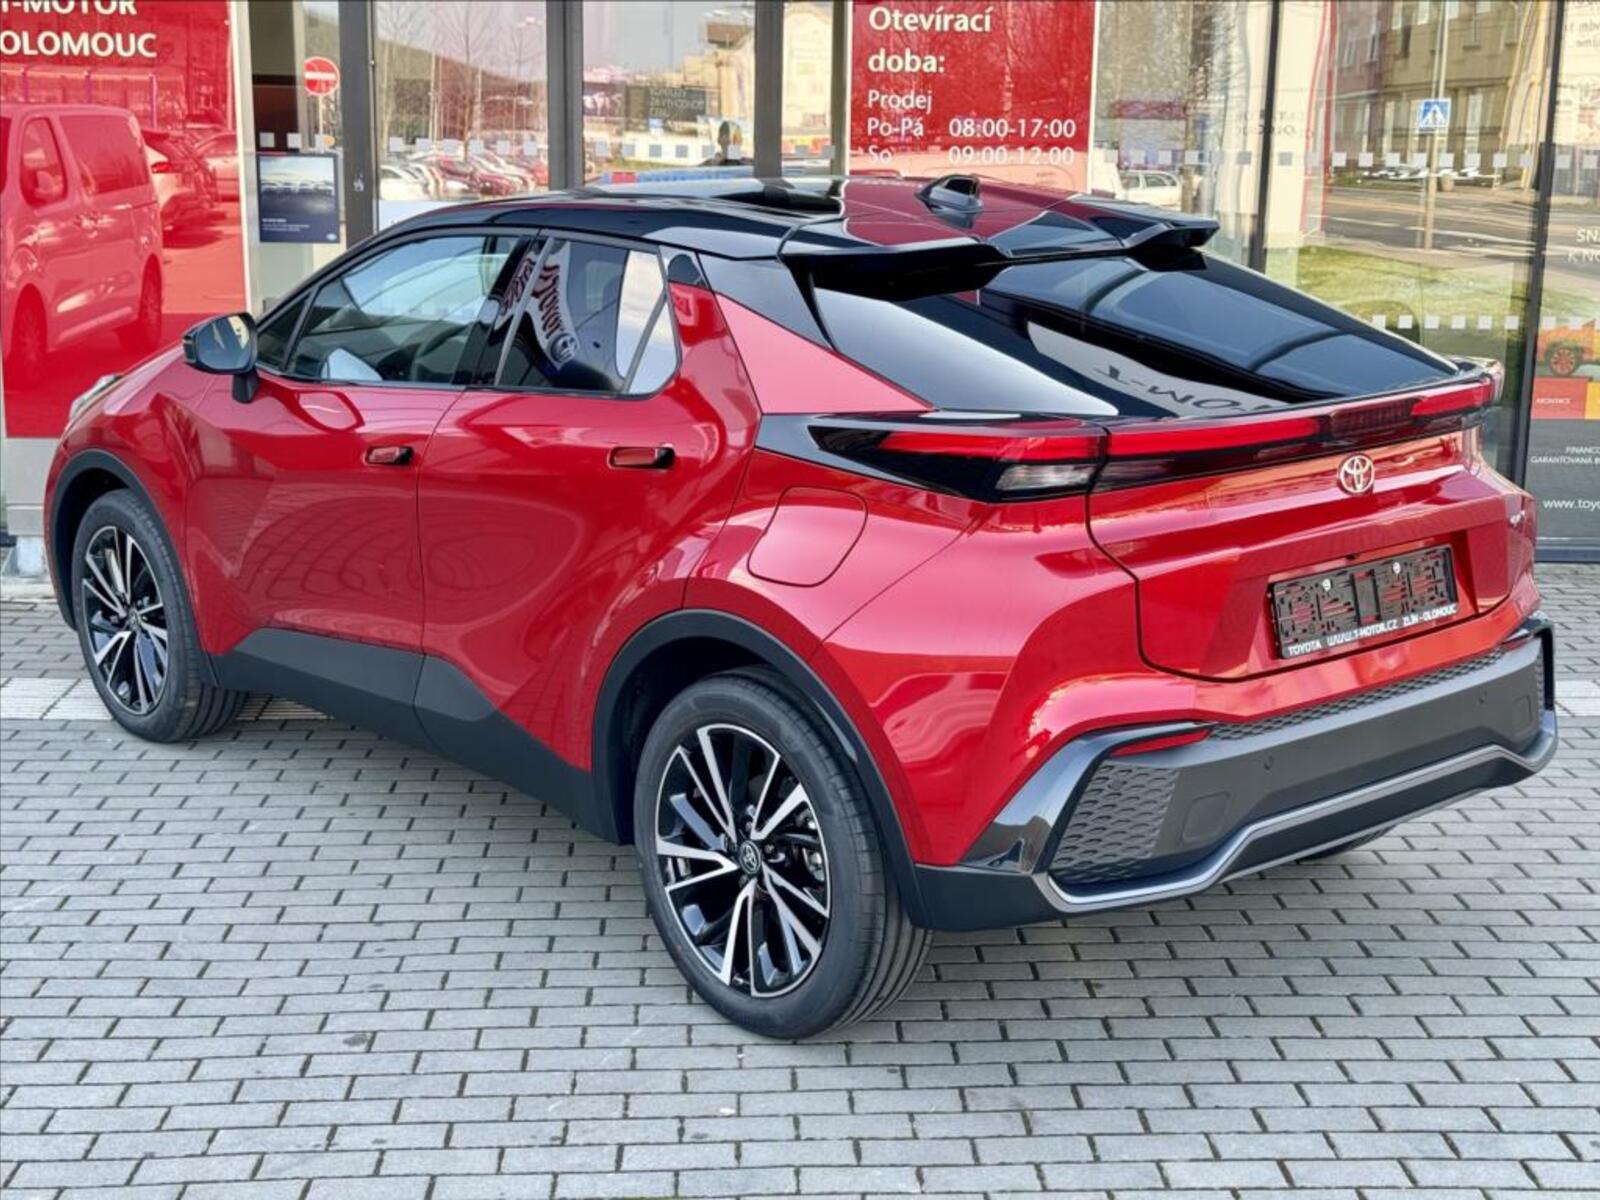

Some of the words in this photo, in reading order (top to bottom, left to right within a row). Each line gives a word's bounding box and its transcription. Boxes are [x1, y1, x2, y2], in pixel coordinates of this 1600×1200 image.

[868, 6, 993, 32] Otevírací
[0, 30, 157, 58] OLOMOUC
[867, 48, 946, 73] doba:
[867, 89, 932, 114] Prodej
[867, 117, 925, 137] Po-Pá
[949, 118, 1077, 139] 08:00-17:00
[948, 146, 1076, 165] 09:00-12:00
[1576, 228, 1600, 243] SN
[1287, 639, 1322, 657] TOYOTA
